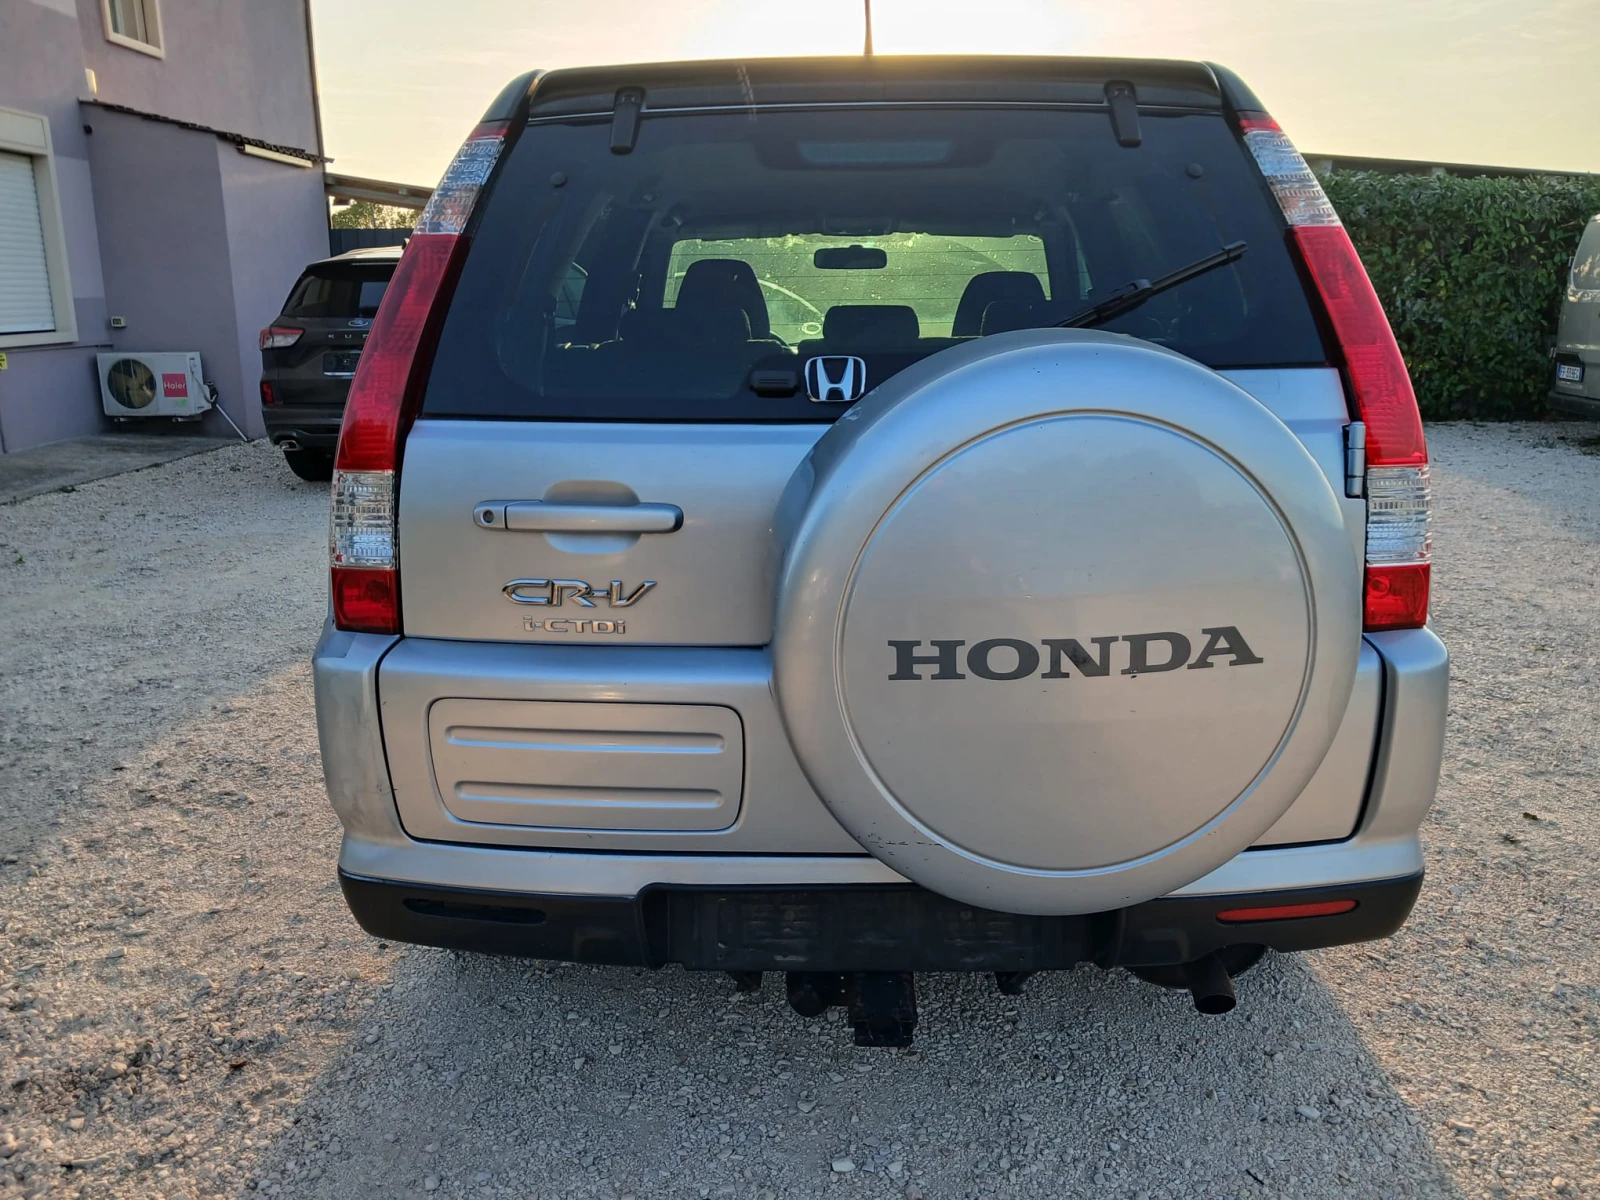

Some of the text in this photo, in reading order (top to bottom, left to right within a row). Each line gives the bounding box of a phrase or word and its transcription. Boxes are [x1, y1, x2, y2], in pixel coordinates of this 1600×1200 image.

[163, 381, 187, 390] Haier
[502, 578, 657, 608] CR-V
[523, 615, 626, 635] i-CTDi
[887, 625, 1264, 681] HONDA
